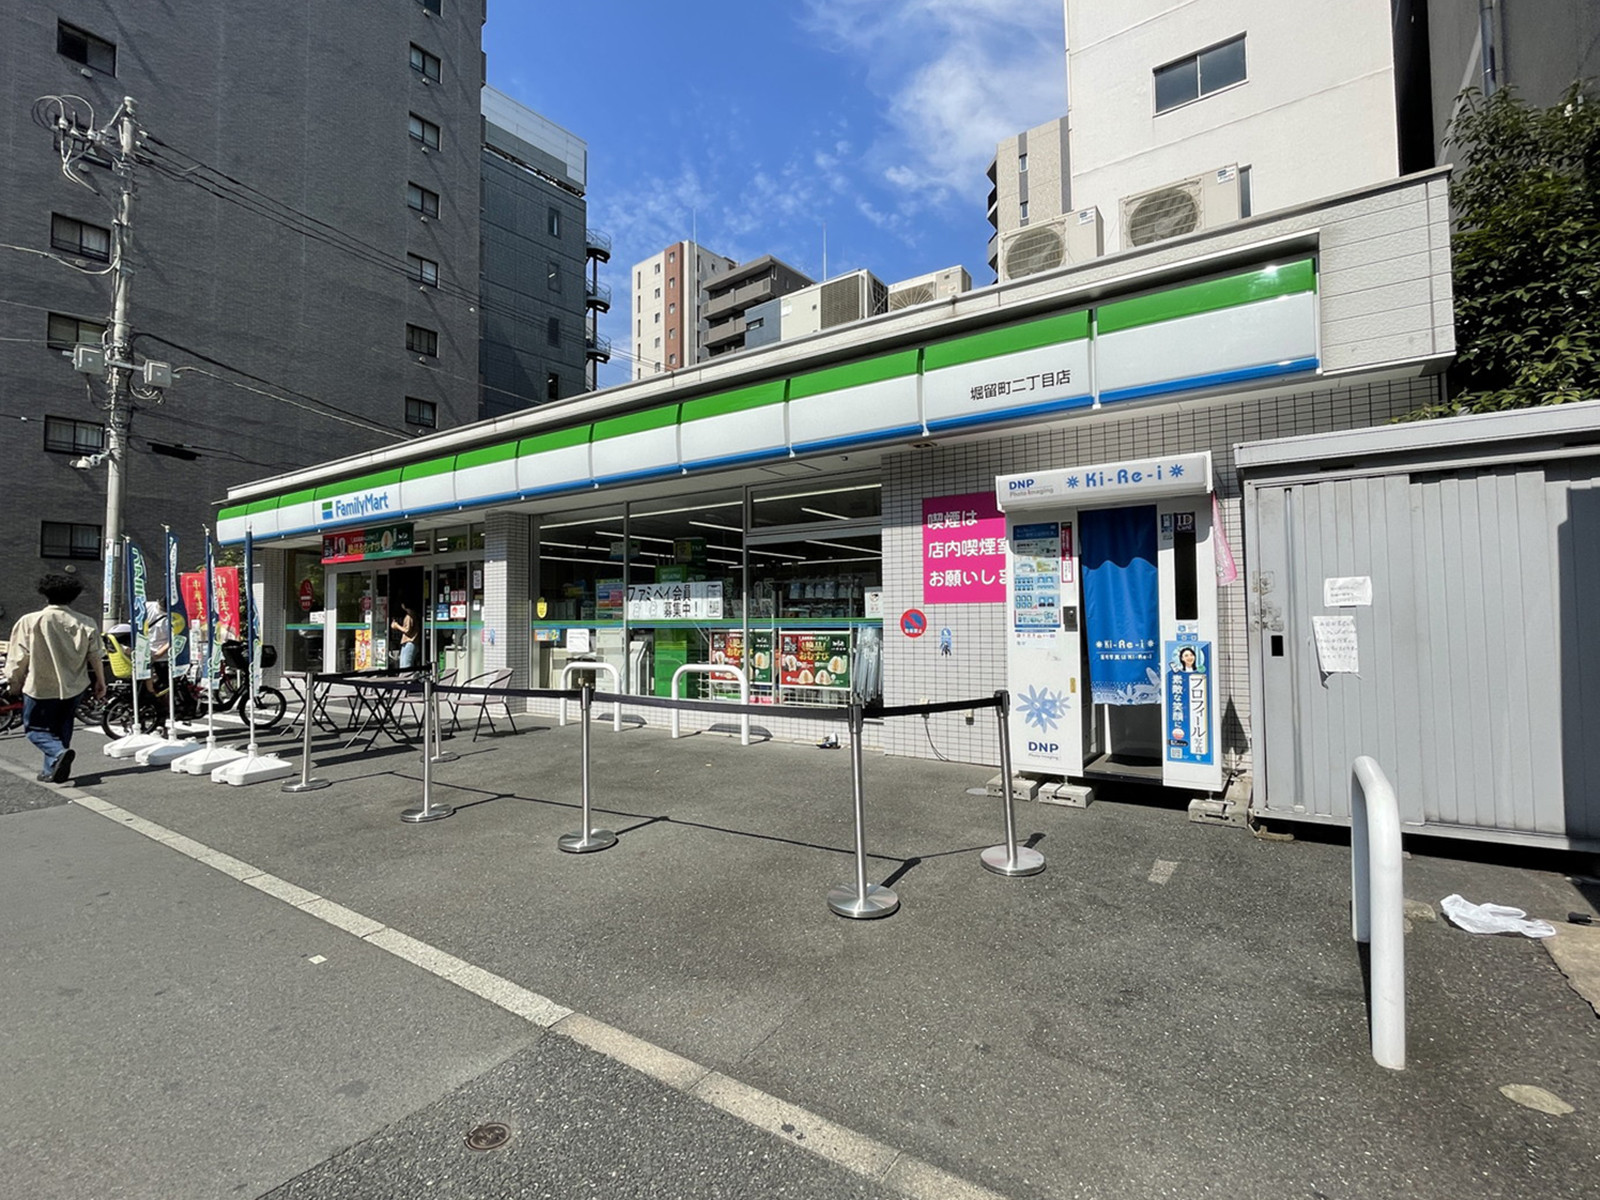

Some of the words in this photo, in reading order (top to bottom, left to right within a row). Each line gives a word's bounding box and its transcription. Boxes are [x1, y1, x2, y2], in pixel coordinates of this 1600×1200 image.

[970, 369, 1071, 400] 堀留町二丁目店
[1008, 478, 1035, 490] DNP
[1085, 465, 1163, 488] Ki-Re-i
[1009, 490, 1027, 498] Photo
[1027, 487, 1054, 497] Imaging
[335, 492, 389, 518] FamilyMart
[927, 510, 978, 530] 喫煙は
[1177, 513, 1193, 525] ID
[628, 584, 691, 602] ファミペイ会員
[1028, 741, 1059, 753] DNP
